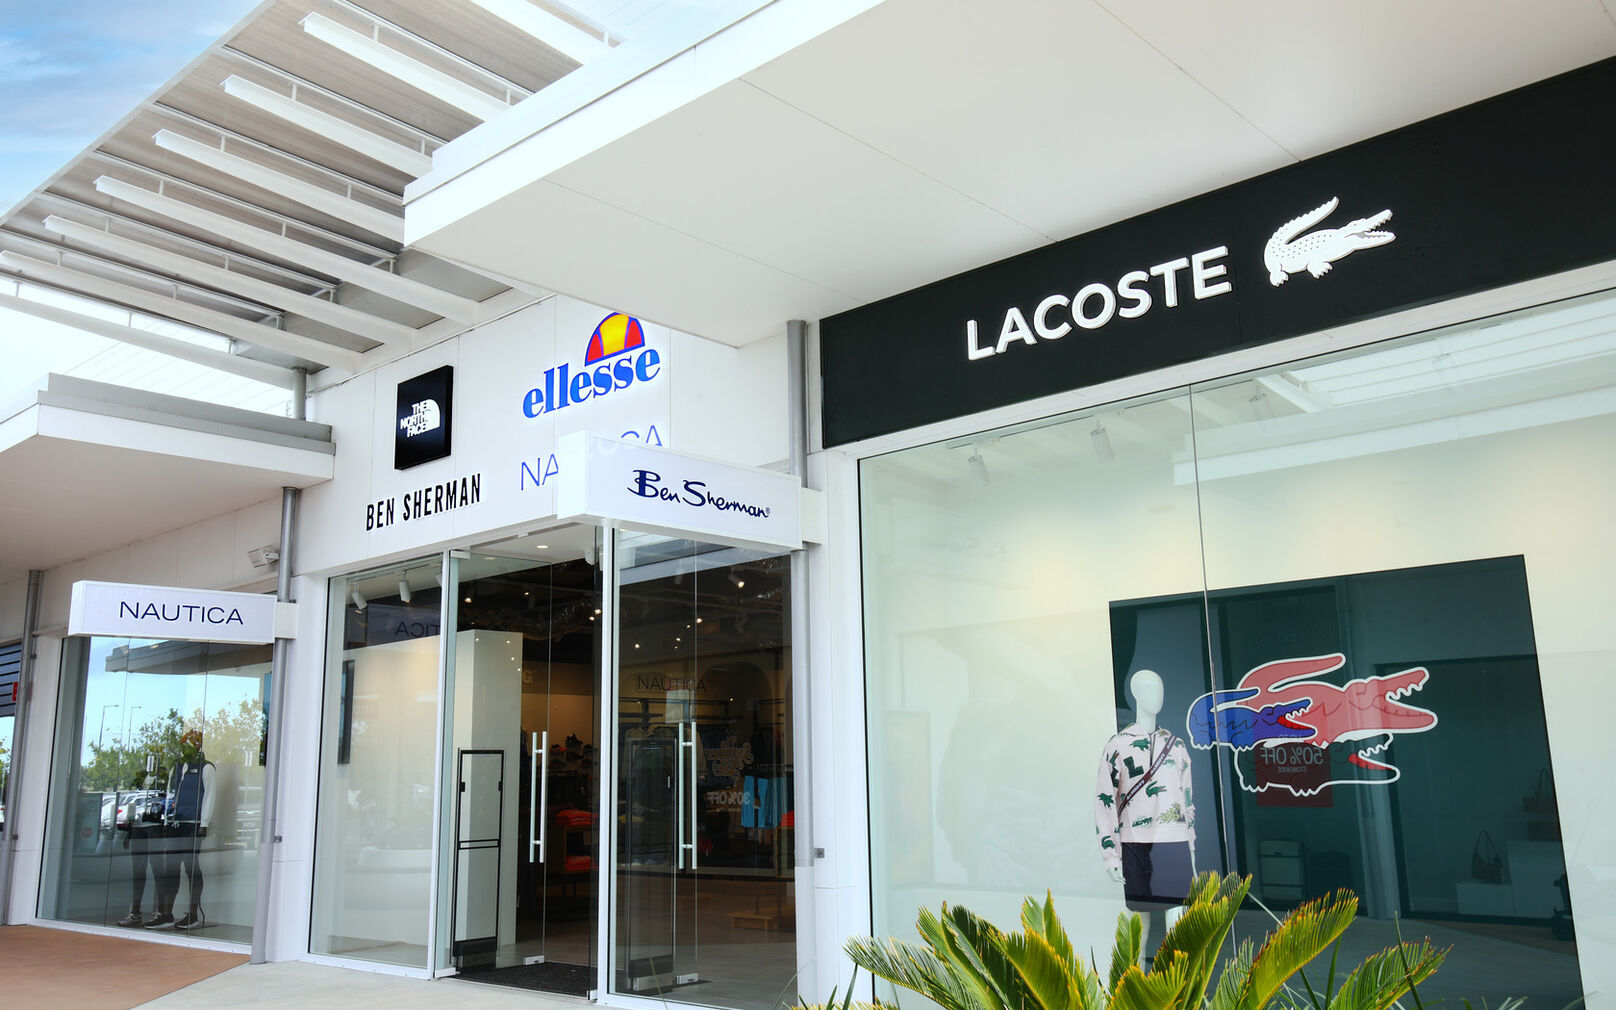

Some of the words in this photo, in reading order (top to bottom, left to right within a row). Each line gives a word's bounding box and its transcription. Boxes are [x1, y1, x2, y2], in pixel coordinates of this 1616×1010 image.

[966, 245, 1232, 361] LACOSTE
[522, 348, 661, 419] ellesse
[411, 401, 427, 415] THE
[365, 497, 395, 532] BEN
[402, 473, 481, 521] SHERMAN
[627, 469, 681, 503] Ben
[119, 601, 244, 626] NAUTICA
